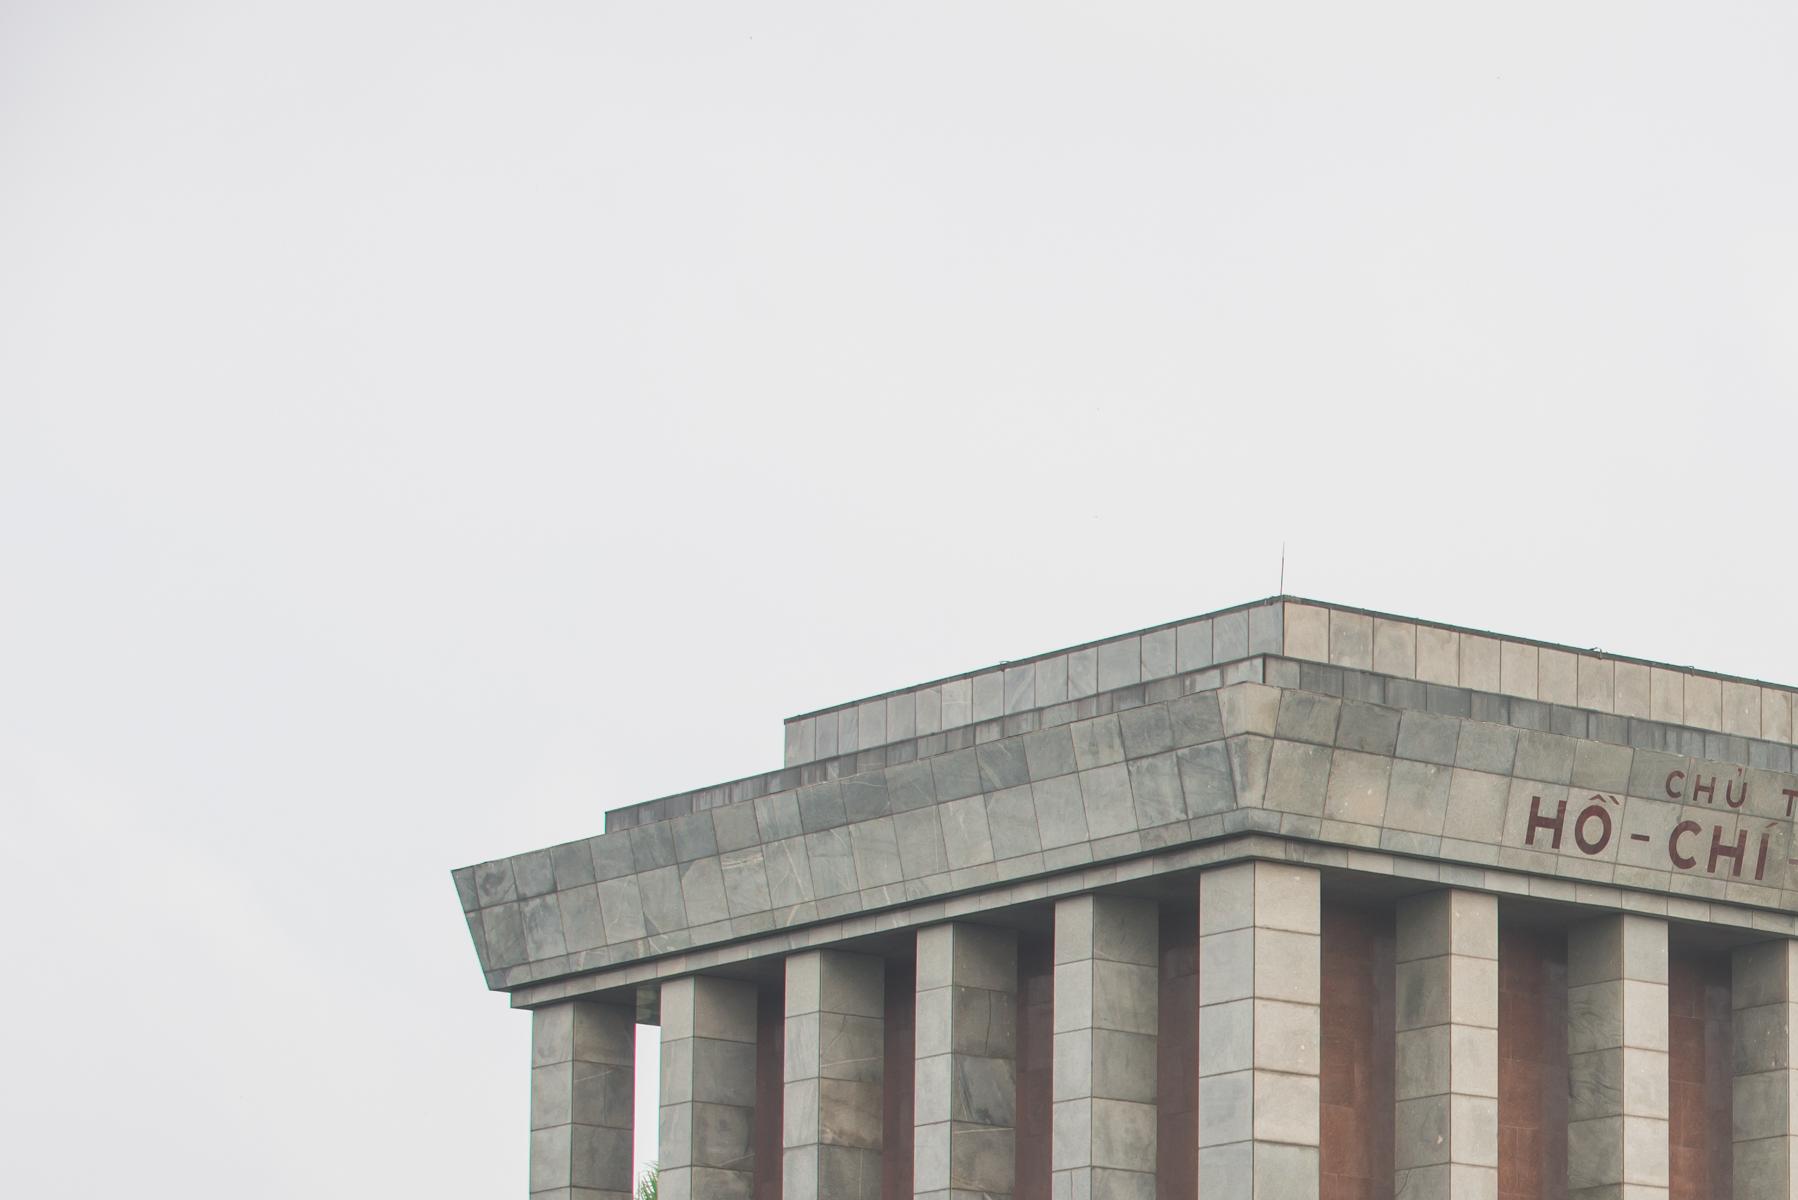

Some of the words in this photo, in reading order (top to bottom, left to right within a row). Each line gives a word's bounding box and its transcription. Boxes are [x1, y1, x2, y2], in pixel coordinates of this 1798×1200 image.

[1665, 767, 1748, 809] CHỦ
[1524, 793, 1620, 856] HỒ
[1668, 820, 1778, 881] CHÍ
